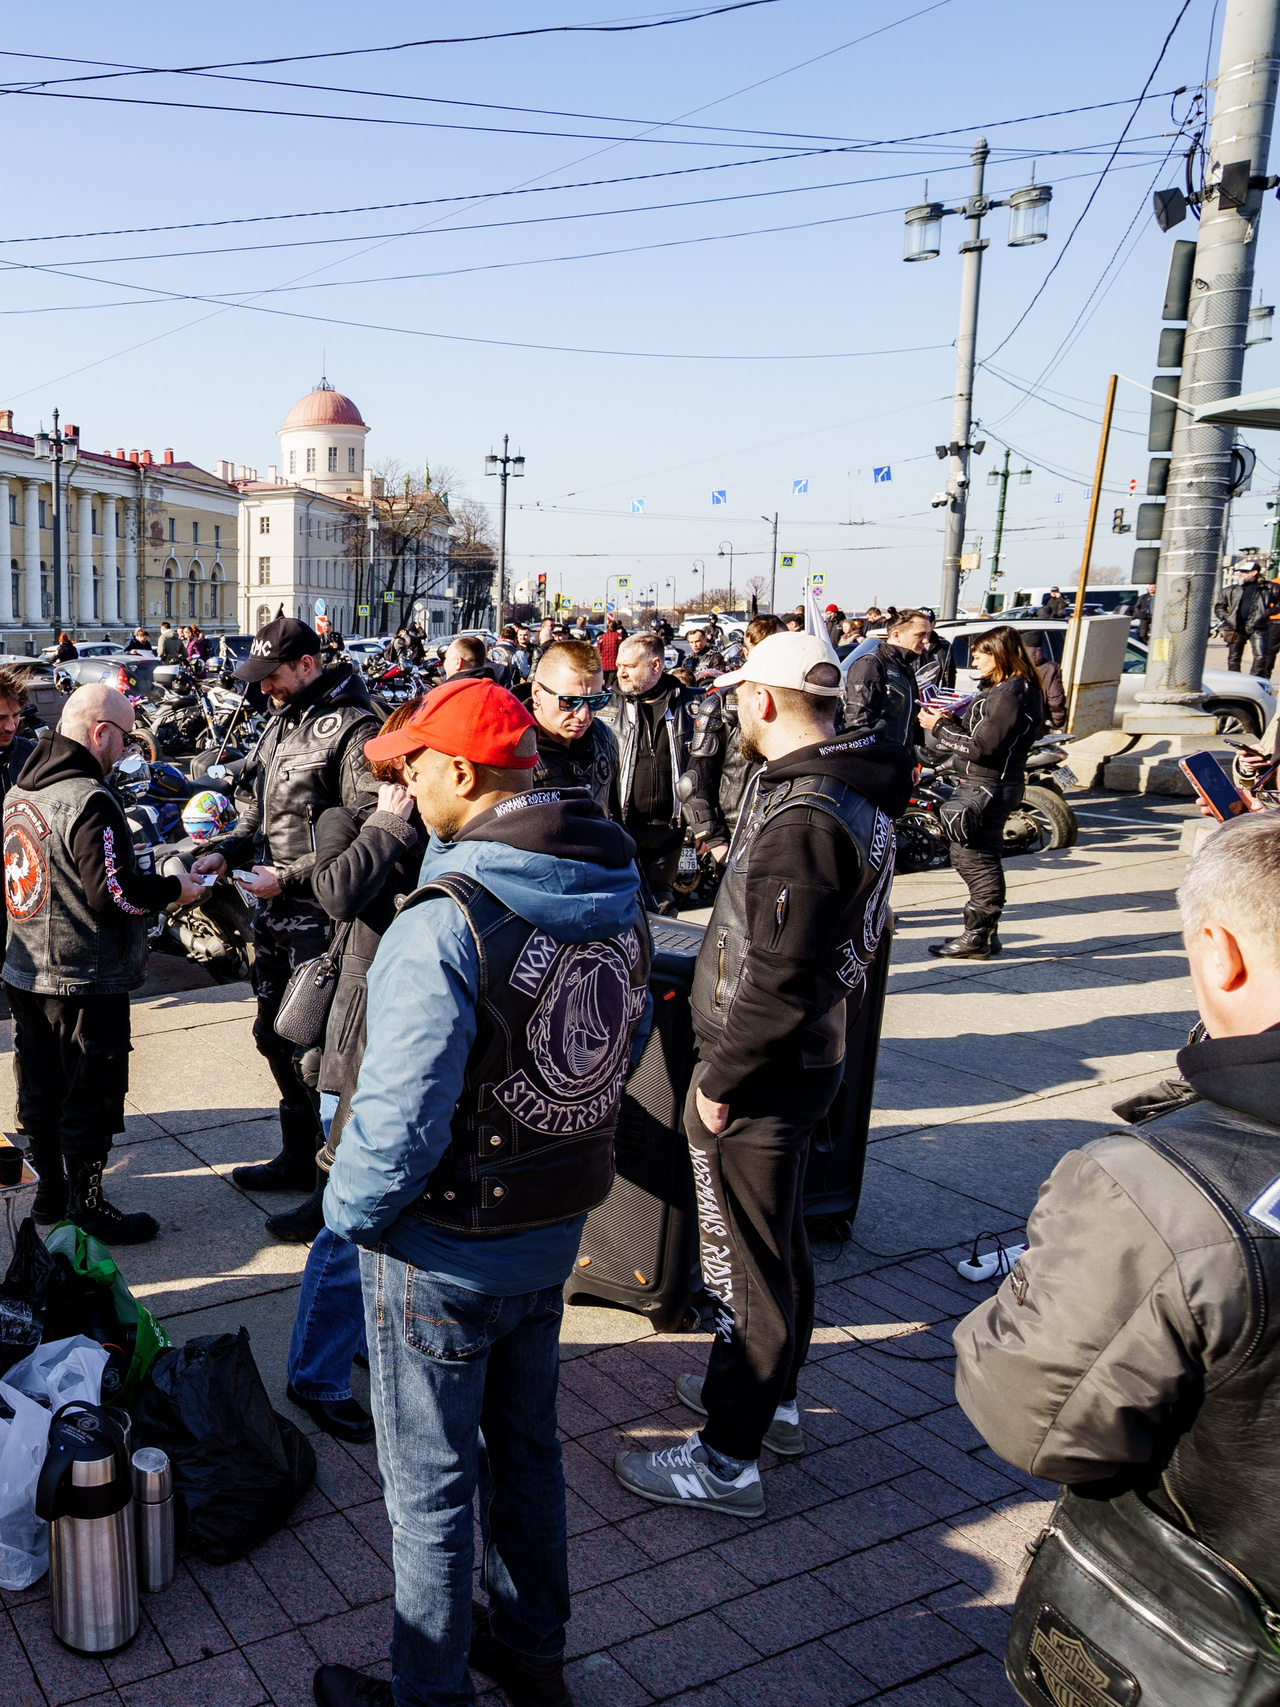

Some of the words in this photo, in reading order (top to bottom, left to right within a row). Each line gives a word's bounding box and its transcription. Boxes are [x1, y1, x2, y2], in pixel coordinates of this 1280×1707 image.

[494, 795, 528, 817] NORMANS
[526, 792, 551, 805] RIDERS
[551, 791, 561, 803] MC
[689, 1143, 728, 1237] NORMANS
[670, 1473, 708, 1499] N
[1055, 1641, 1097, 1684] MOTOR
